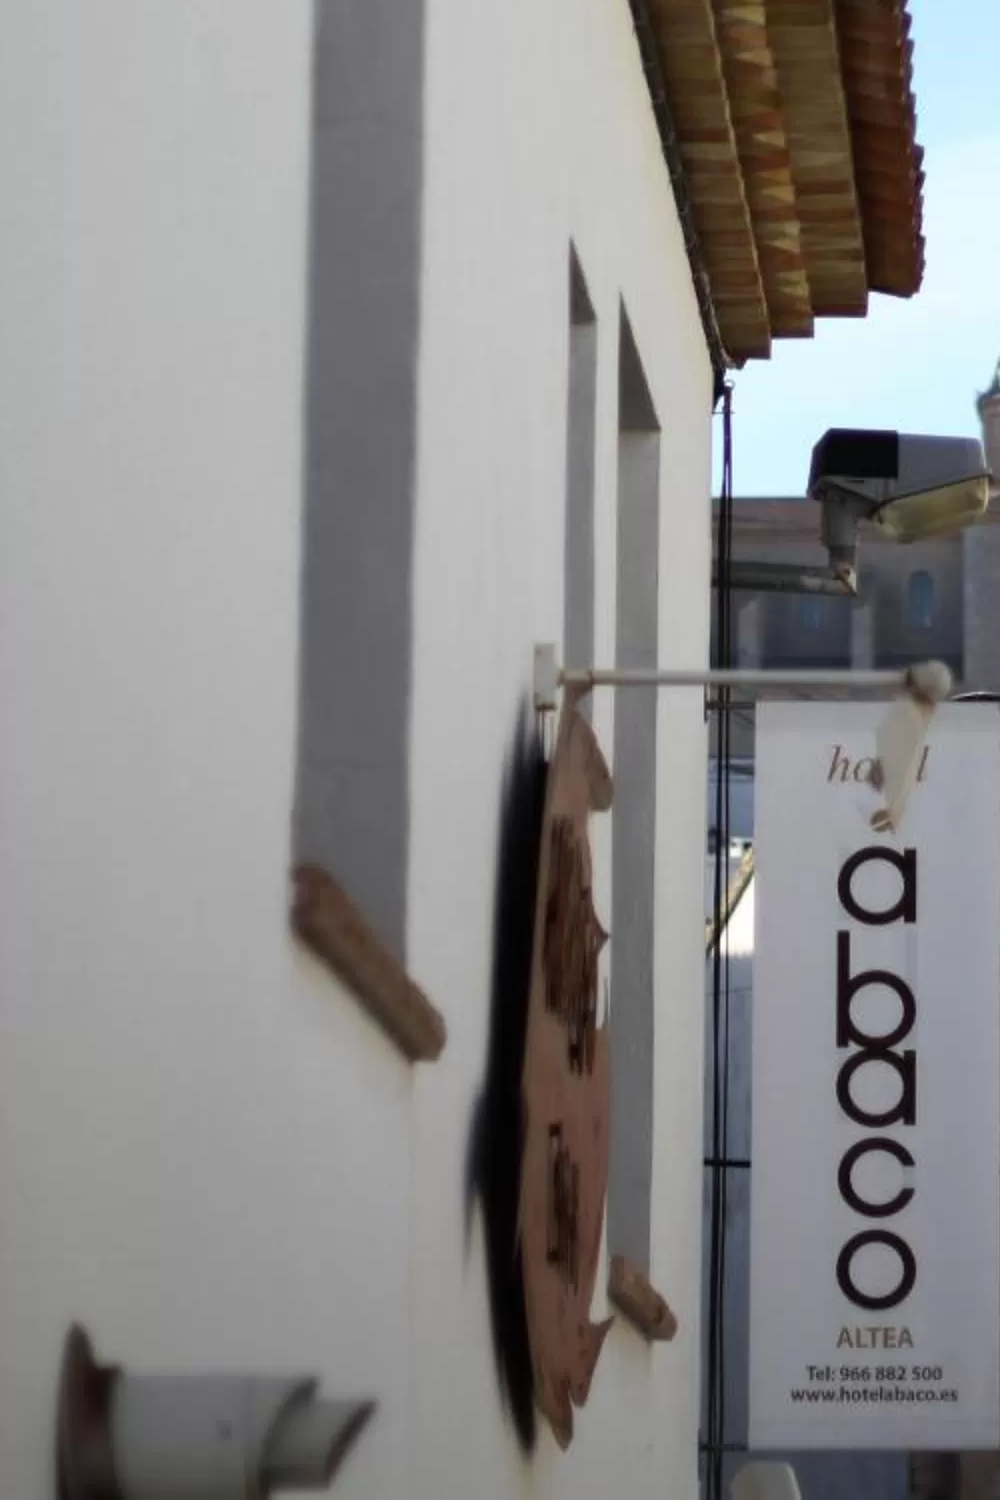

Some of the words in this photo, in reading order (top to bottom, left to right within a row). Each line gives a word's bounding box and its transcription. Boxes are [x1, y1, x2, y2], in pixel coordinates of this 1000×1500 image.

[827, 745, 931, 783] hol
[836, 845, 917, 1311] abaco
[836, 1326, 915, 1349] ALTEA
[806, 1364, 835, 1382] Tel:
[839, 1365, 872, 1382] 966
[875, 1365, 907, 1382] 882
[911, 1365, 943, 1382] 500
[790, 1385, 959, 1403] www.hotelabaco.es
